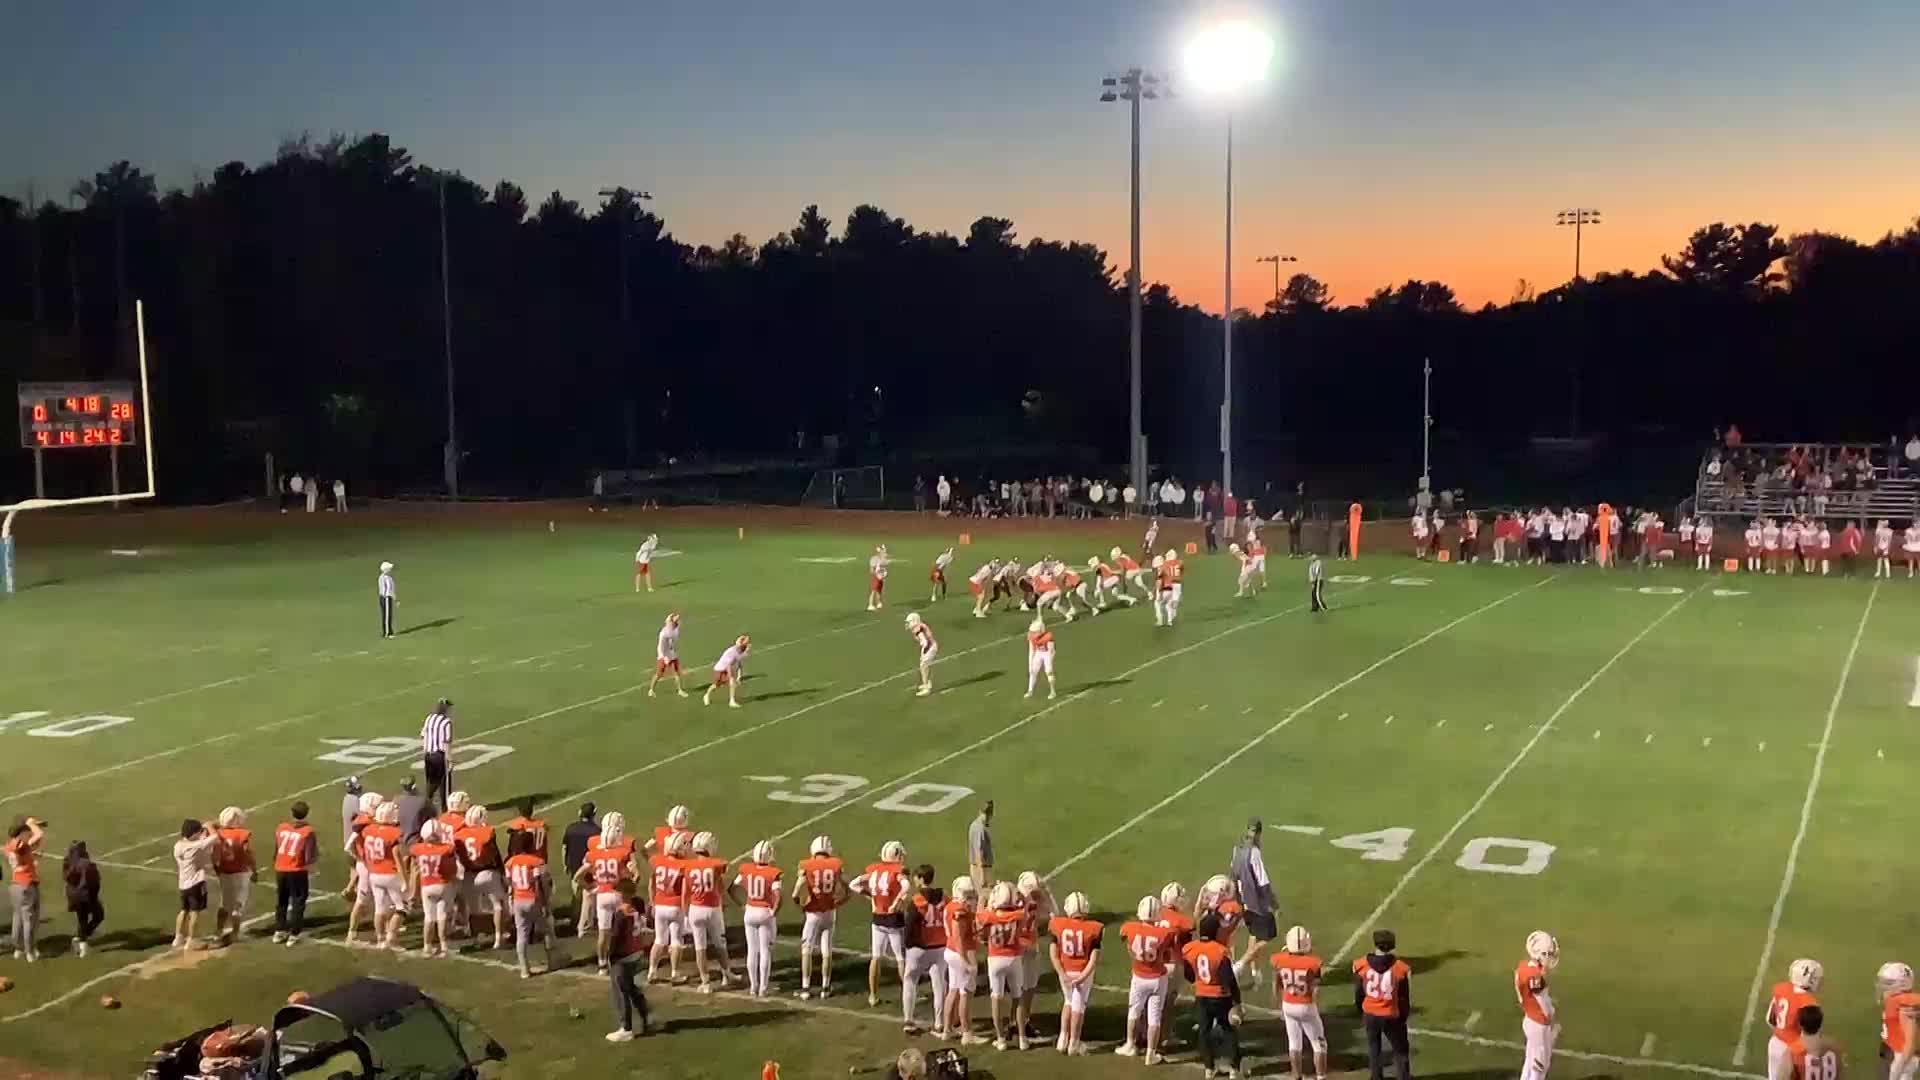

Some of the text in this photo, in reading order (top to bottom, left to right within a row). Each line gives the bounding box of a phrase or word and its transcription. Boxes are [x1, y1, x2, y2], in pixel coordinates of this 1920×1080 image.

[34, 405, 44, 420] 0
[112, 403, 130, 418] 28
[37, 431, 48, 444] 4
[84, 429, 103, 443] 24
[111, 429, 120, 443] 2
[767, 772, 976, 814] 30
[278, 830, 302, 856] 77
[1329, 826, 1557, 875] 40
[747, 874, 765, 900] 10
[1061, 929, 1085, 957] 61
[1366, 968, 1393, 1000] 24
